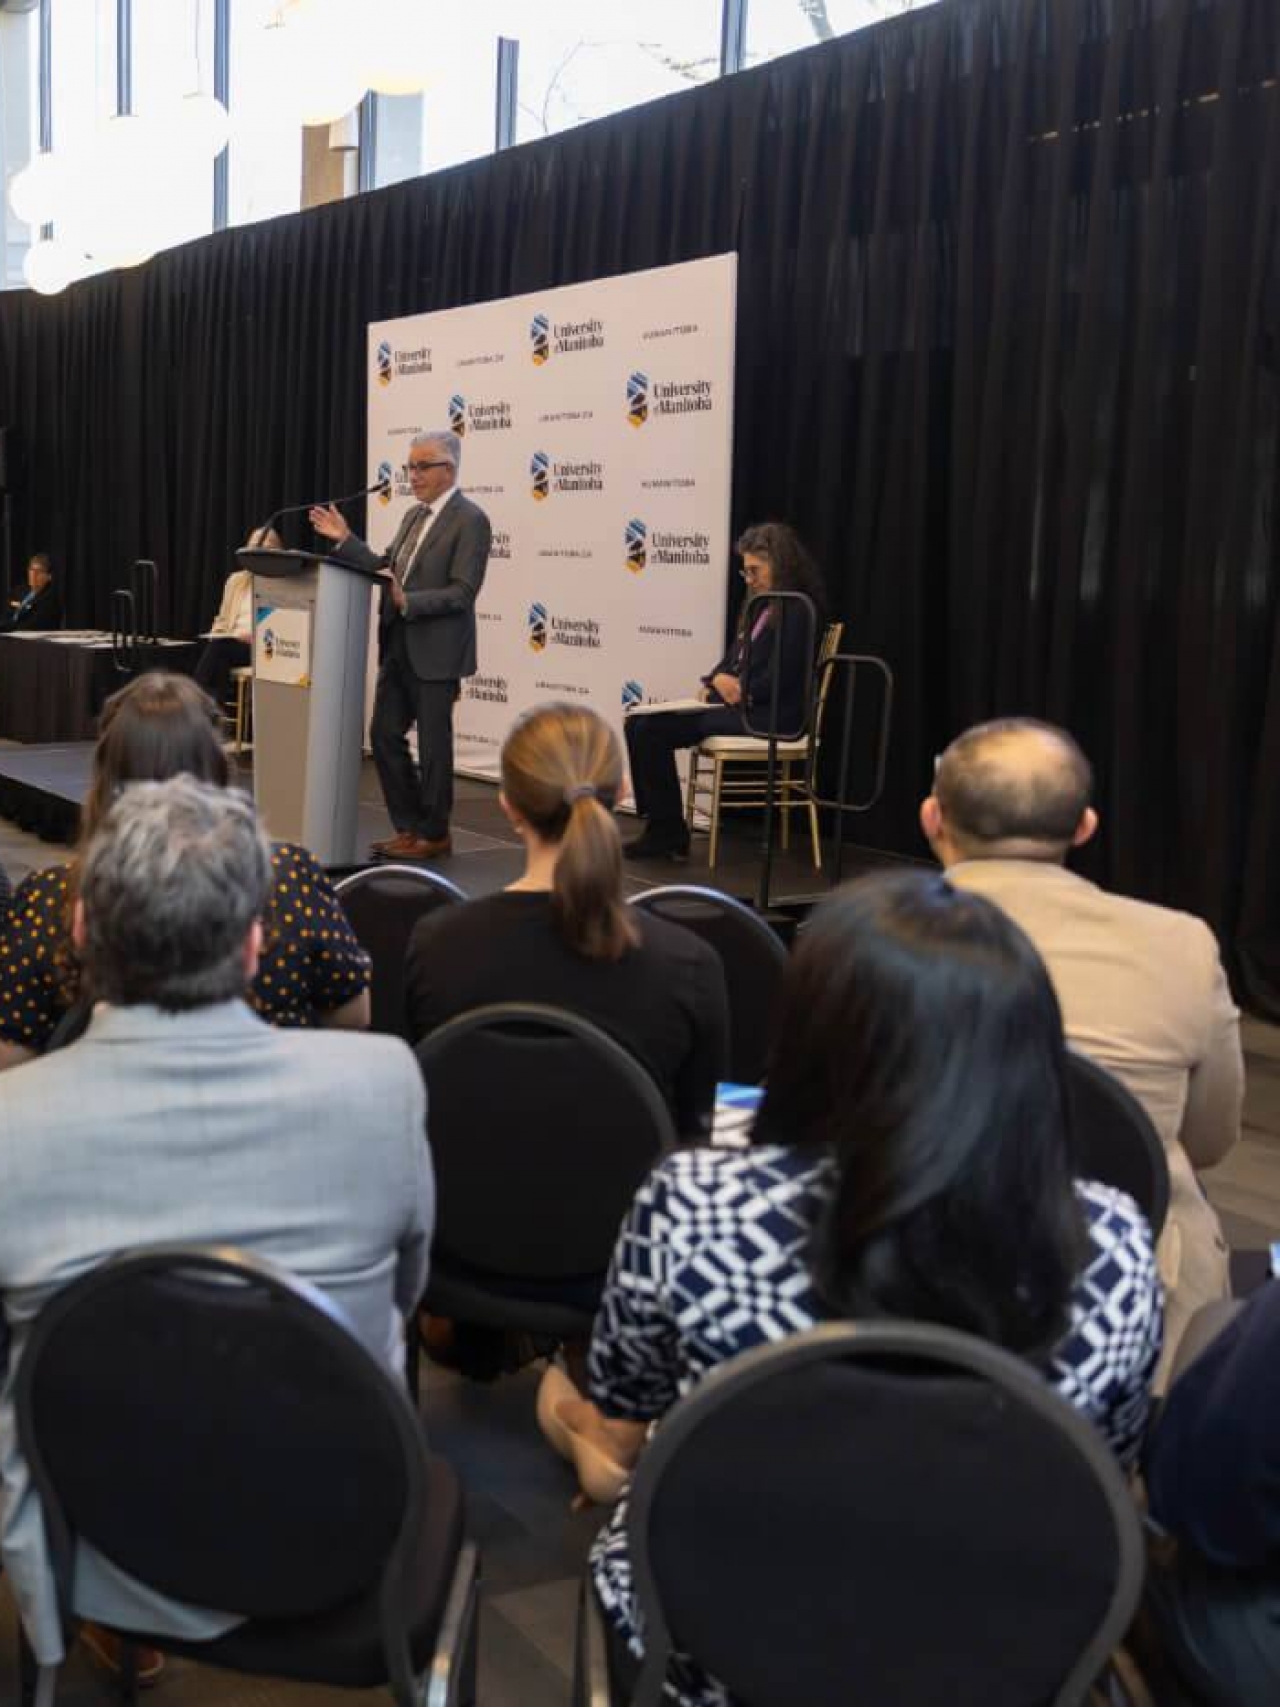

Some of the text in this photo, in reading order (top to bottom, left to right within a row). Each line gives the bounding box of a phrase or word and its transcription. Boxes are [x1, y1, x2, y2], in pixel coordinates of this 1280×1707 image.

[553, 319, 603, 338] University
[558, 333, 604, 352] Manitoba
[394, 349, 432, 363] University
[653, 380, 711, 399] University
[468, 401, 511, 418] University
[659, 397, 712, 414] Manitoba
[553, 461, 603, 479] University
[558, 476, 603, 491] Manitoba
[652, 532, 710, 549] University
[657, 547, 710, 564] Manitoba
[551, 617, 600, 634] University
[556, 631, 601, 648] Manitoba
